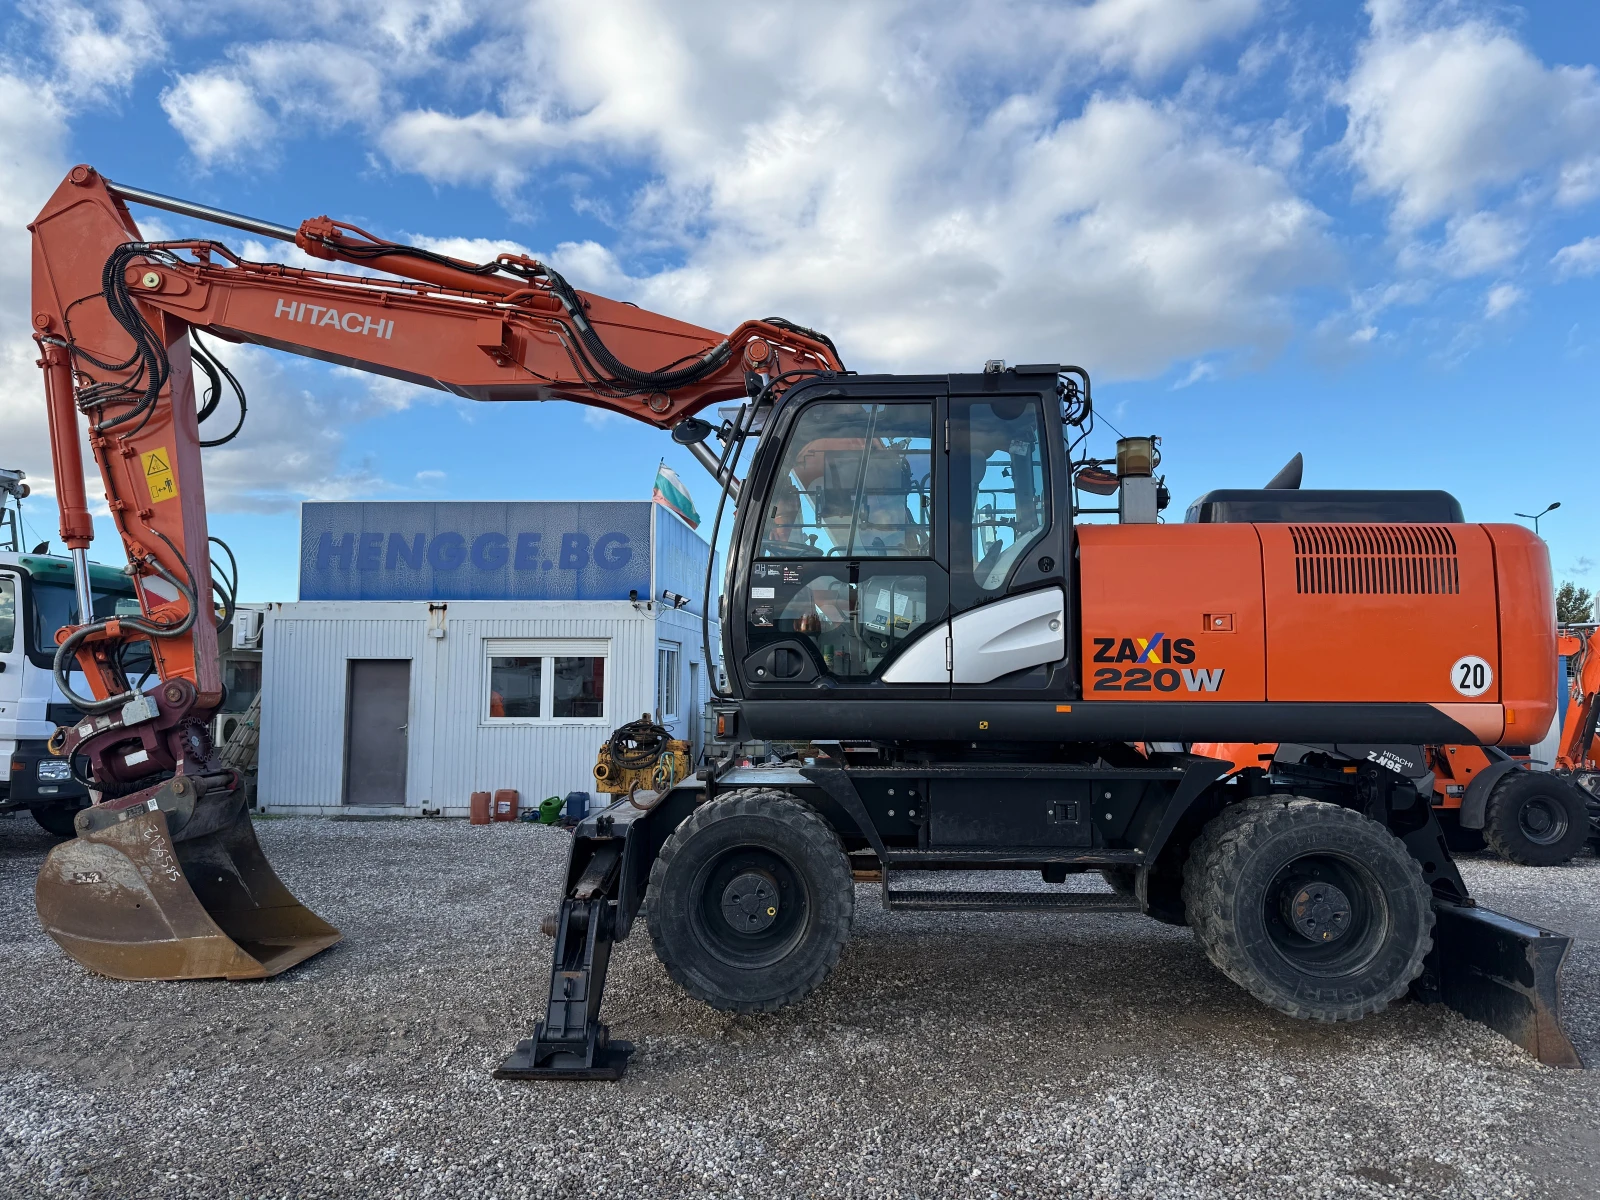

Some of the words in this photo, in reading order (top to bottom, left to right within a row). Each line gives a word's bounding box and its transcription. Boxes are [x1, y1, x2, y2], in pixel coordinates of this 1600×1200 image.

[274, 298, 395, 340] HITACHI
[315, 531, 632, 572] HENGGE.BG
[1093, 632, 1196, 664] ZAXIS
[1093, 667, 1225, 692] 220W
[1459, 663, 1485, 689] 20
[1382, 750, 1414, 769] HITACHI
